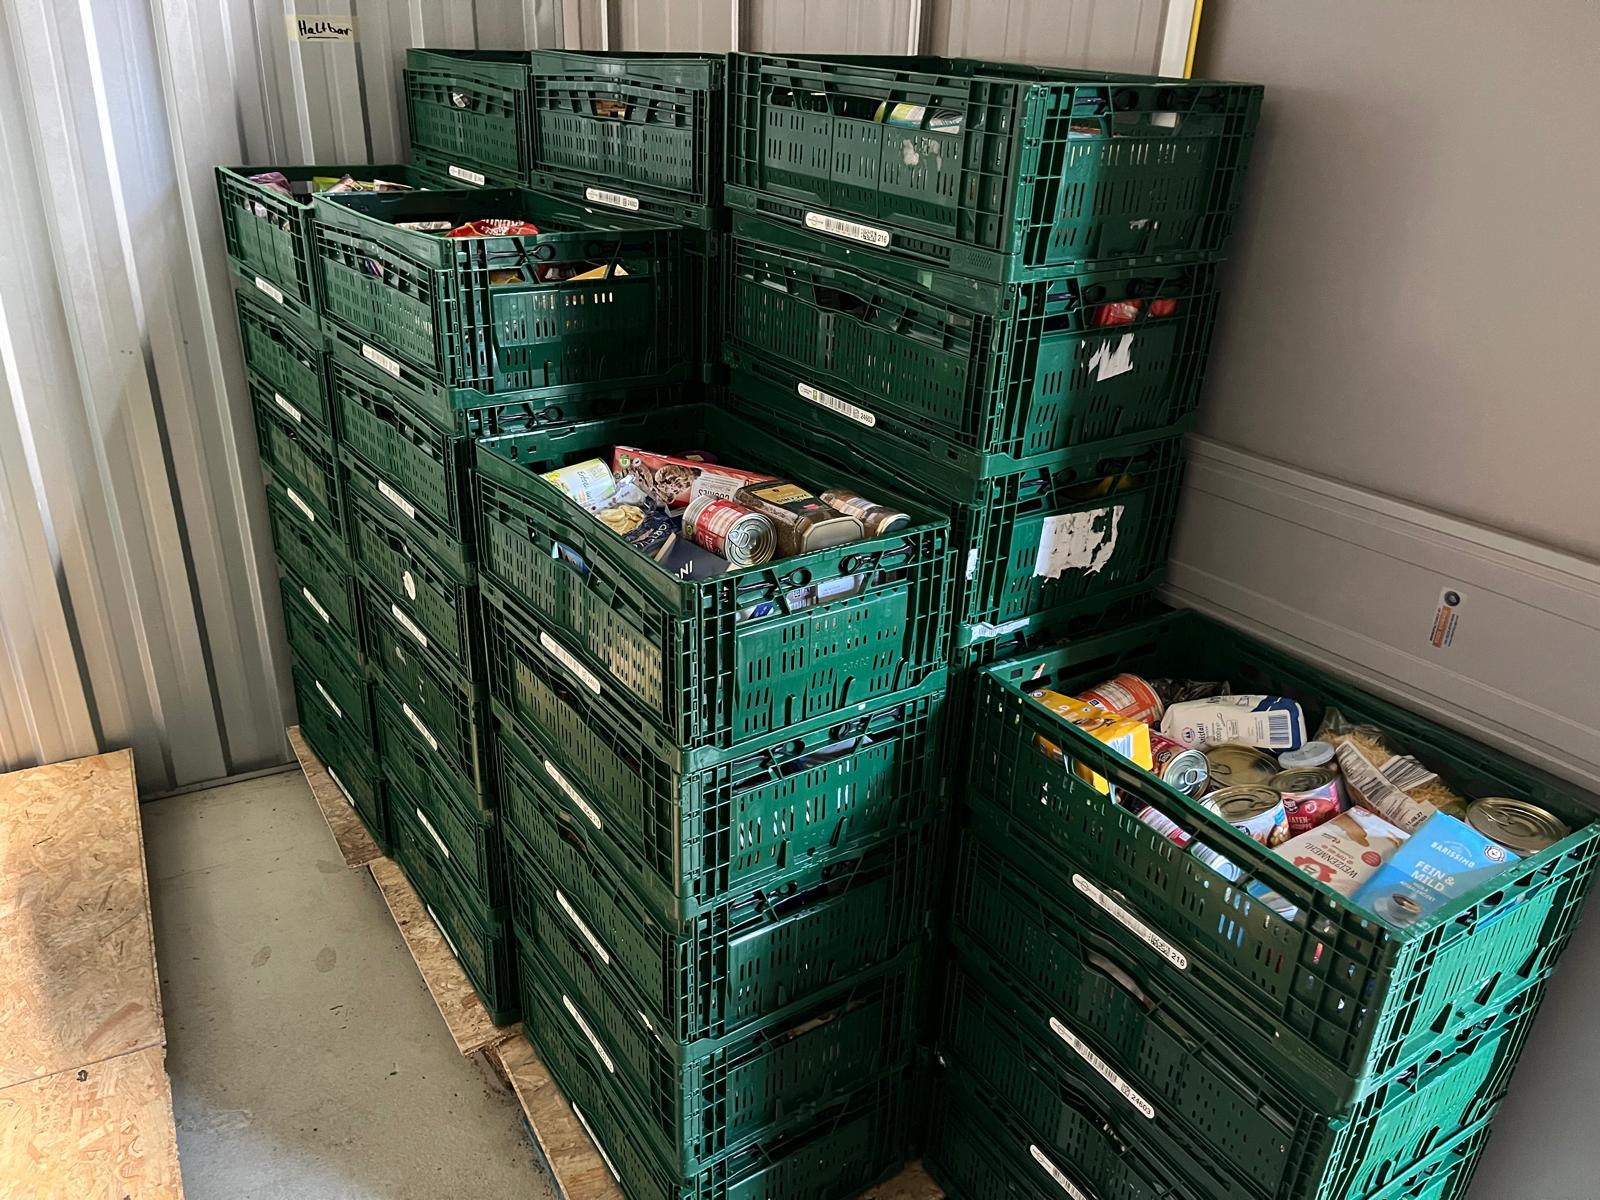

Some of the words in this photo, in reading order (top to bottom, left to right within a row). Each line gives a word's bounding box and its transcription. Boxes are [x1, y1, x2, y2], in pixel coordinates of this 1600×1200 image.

[298, 20, 352, 36] Haltbar
[1305, 842, 1359, 879] WEIZENMEHL
[1430, 841, 1476, 868] BARISSIMO
[1411, 870, 1445, 892] MILD
[1414, 860, 1446, 880] FEIN
[1444, 876, 1455, 887] &
[1171, 952, 1185, 967] 216
[1131, 1093, 1151, 1115] 24603
